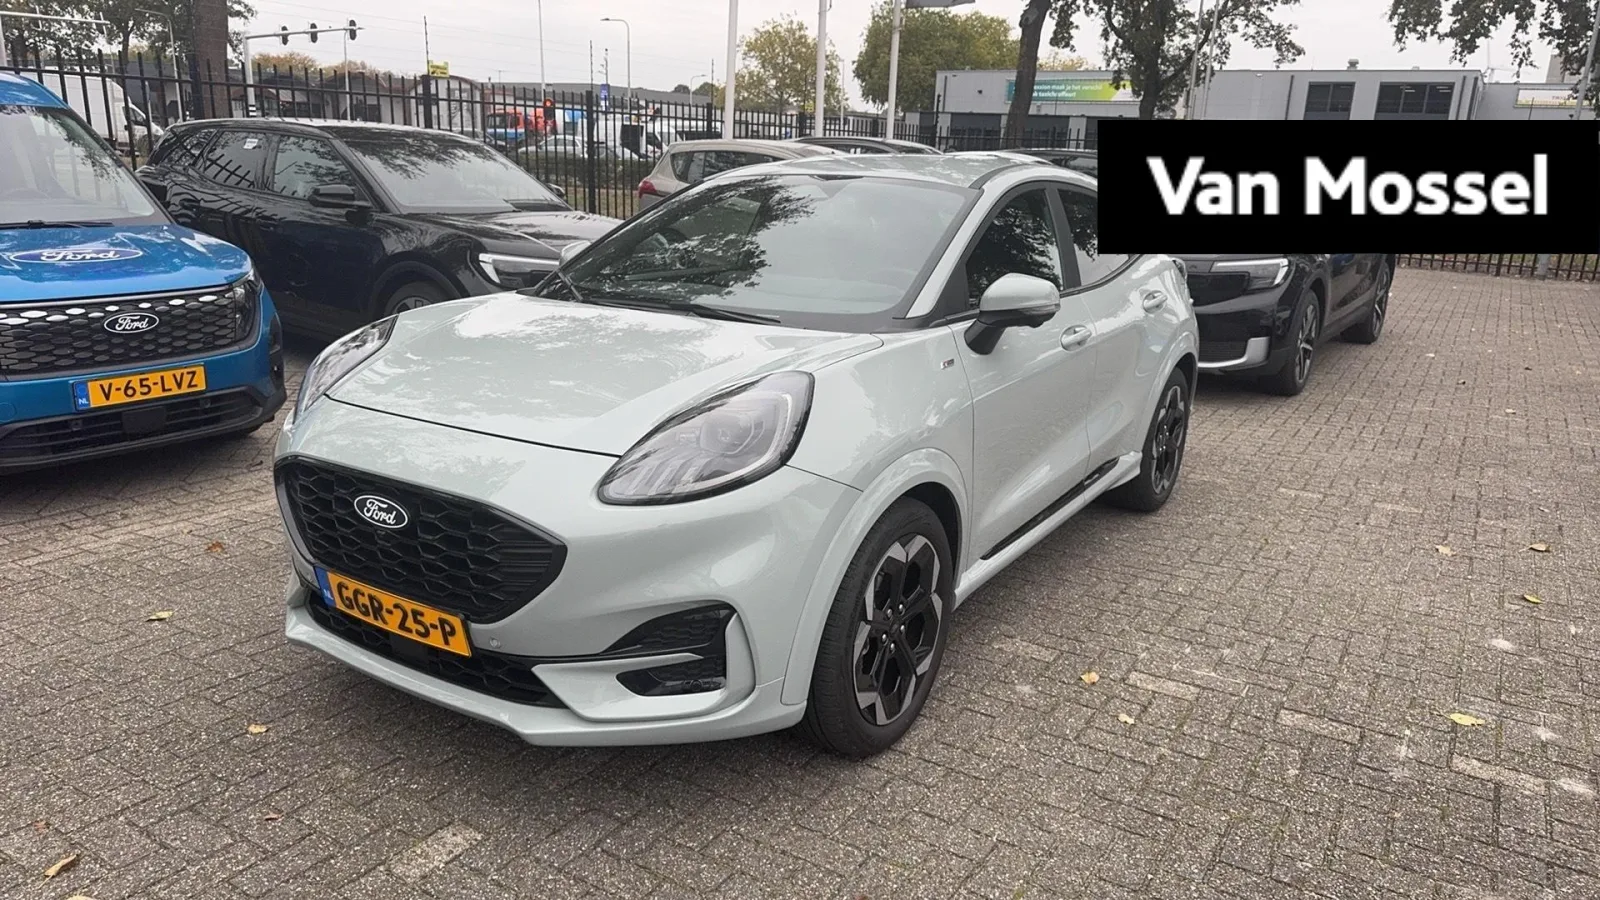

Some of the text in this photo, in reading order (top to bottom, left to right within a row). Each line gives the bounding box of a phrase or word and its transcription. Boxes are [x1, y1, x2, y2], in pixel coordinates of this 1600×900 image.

[40, 248, 120, 262] Ford
[115, 315, 149, 331] Ford
[99, 370, 199, 402] V-65-LVZ
[78, 397, 90, 405] NL
[363, 498, 397, 525] Ford
[336, 581, 457, 646] GGR-25-P
